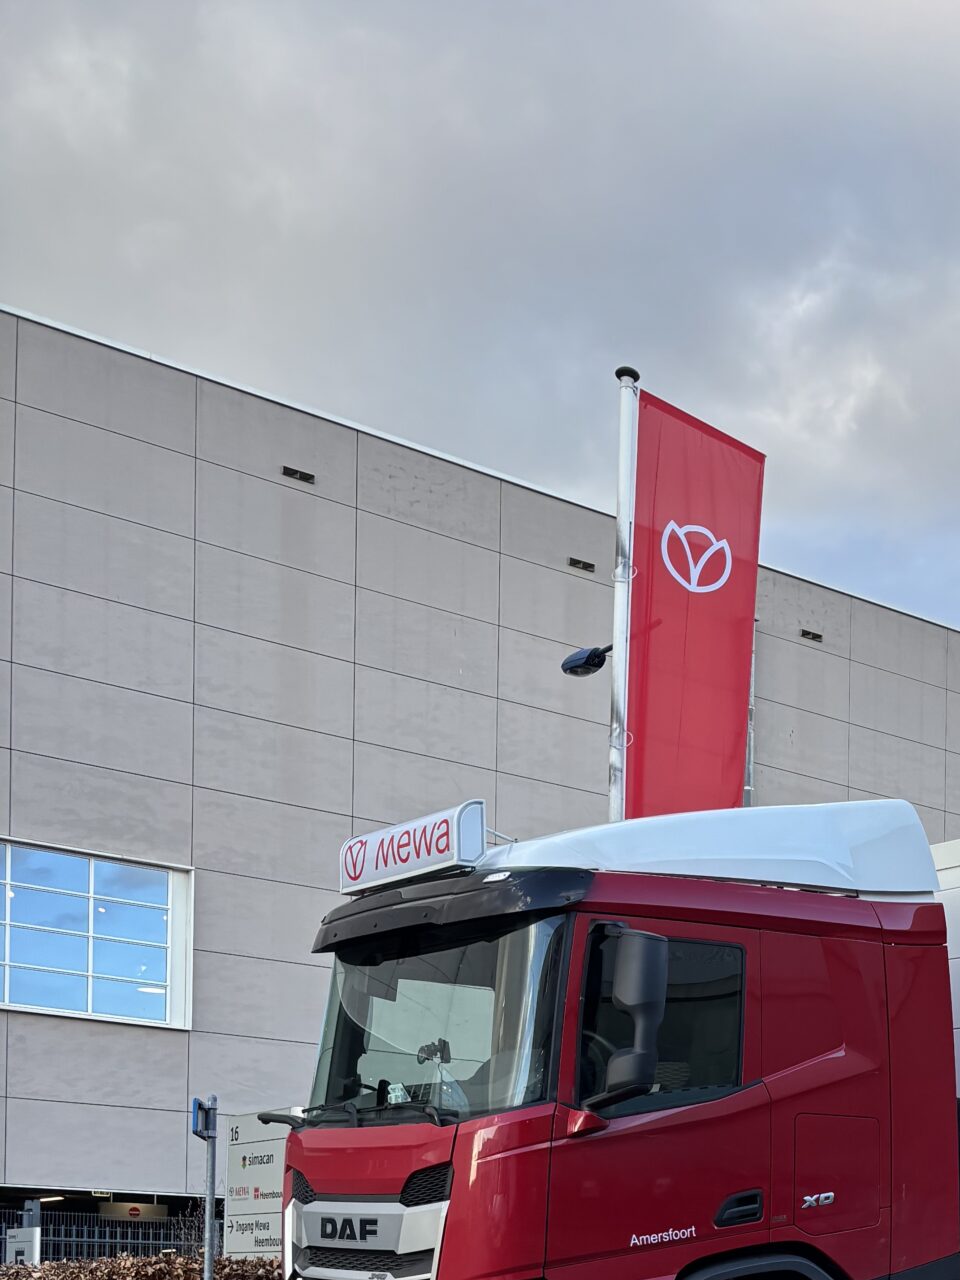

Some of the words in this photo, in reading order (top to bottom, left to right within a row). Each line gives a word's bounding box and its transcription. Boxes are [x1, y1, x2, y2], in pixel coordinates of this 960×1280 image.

[230, 1126, 239, 1141] 16
[248, 1152, 274, 1166] simacan
[260, 1190, 283, 1199] Heembou
[801, 1192, 835, 1209] XD
[235, 1220, 254, 1235] Ingang
[254, 1220, 270, 1231] Mewa
[320, 1217, 379, 1241] DAF
[630, 1225, 696, 1247] Amersfoort
